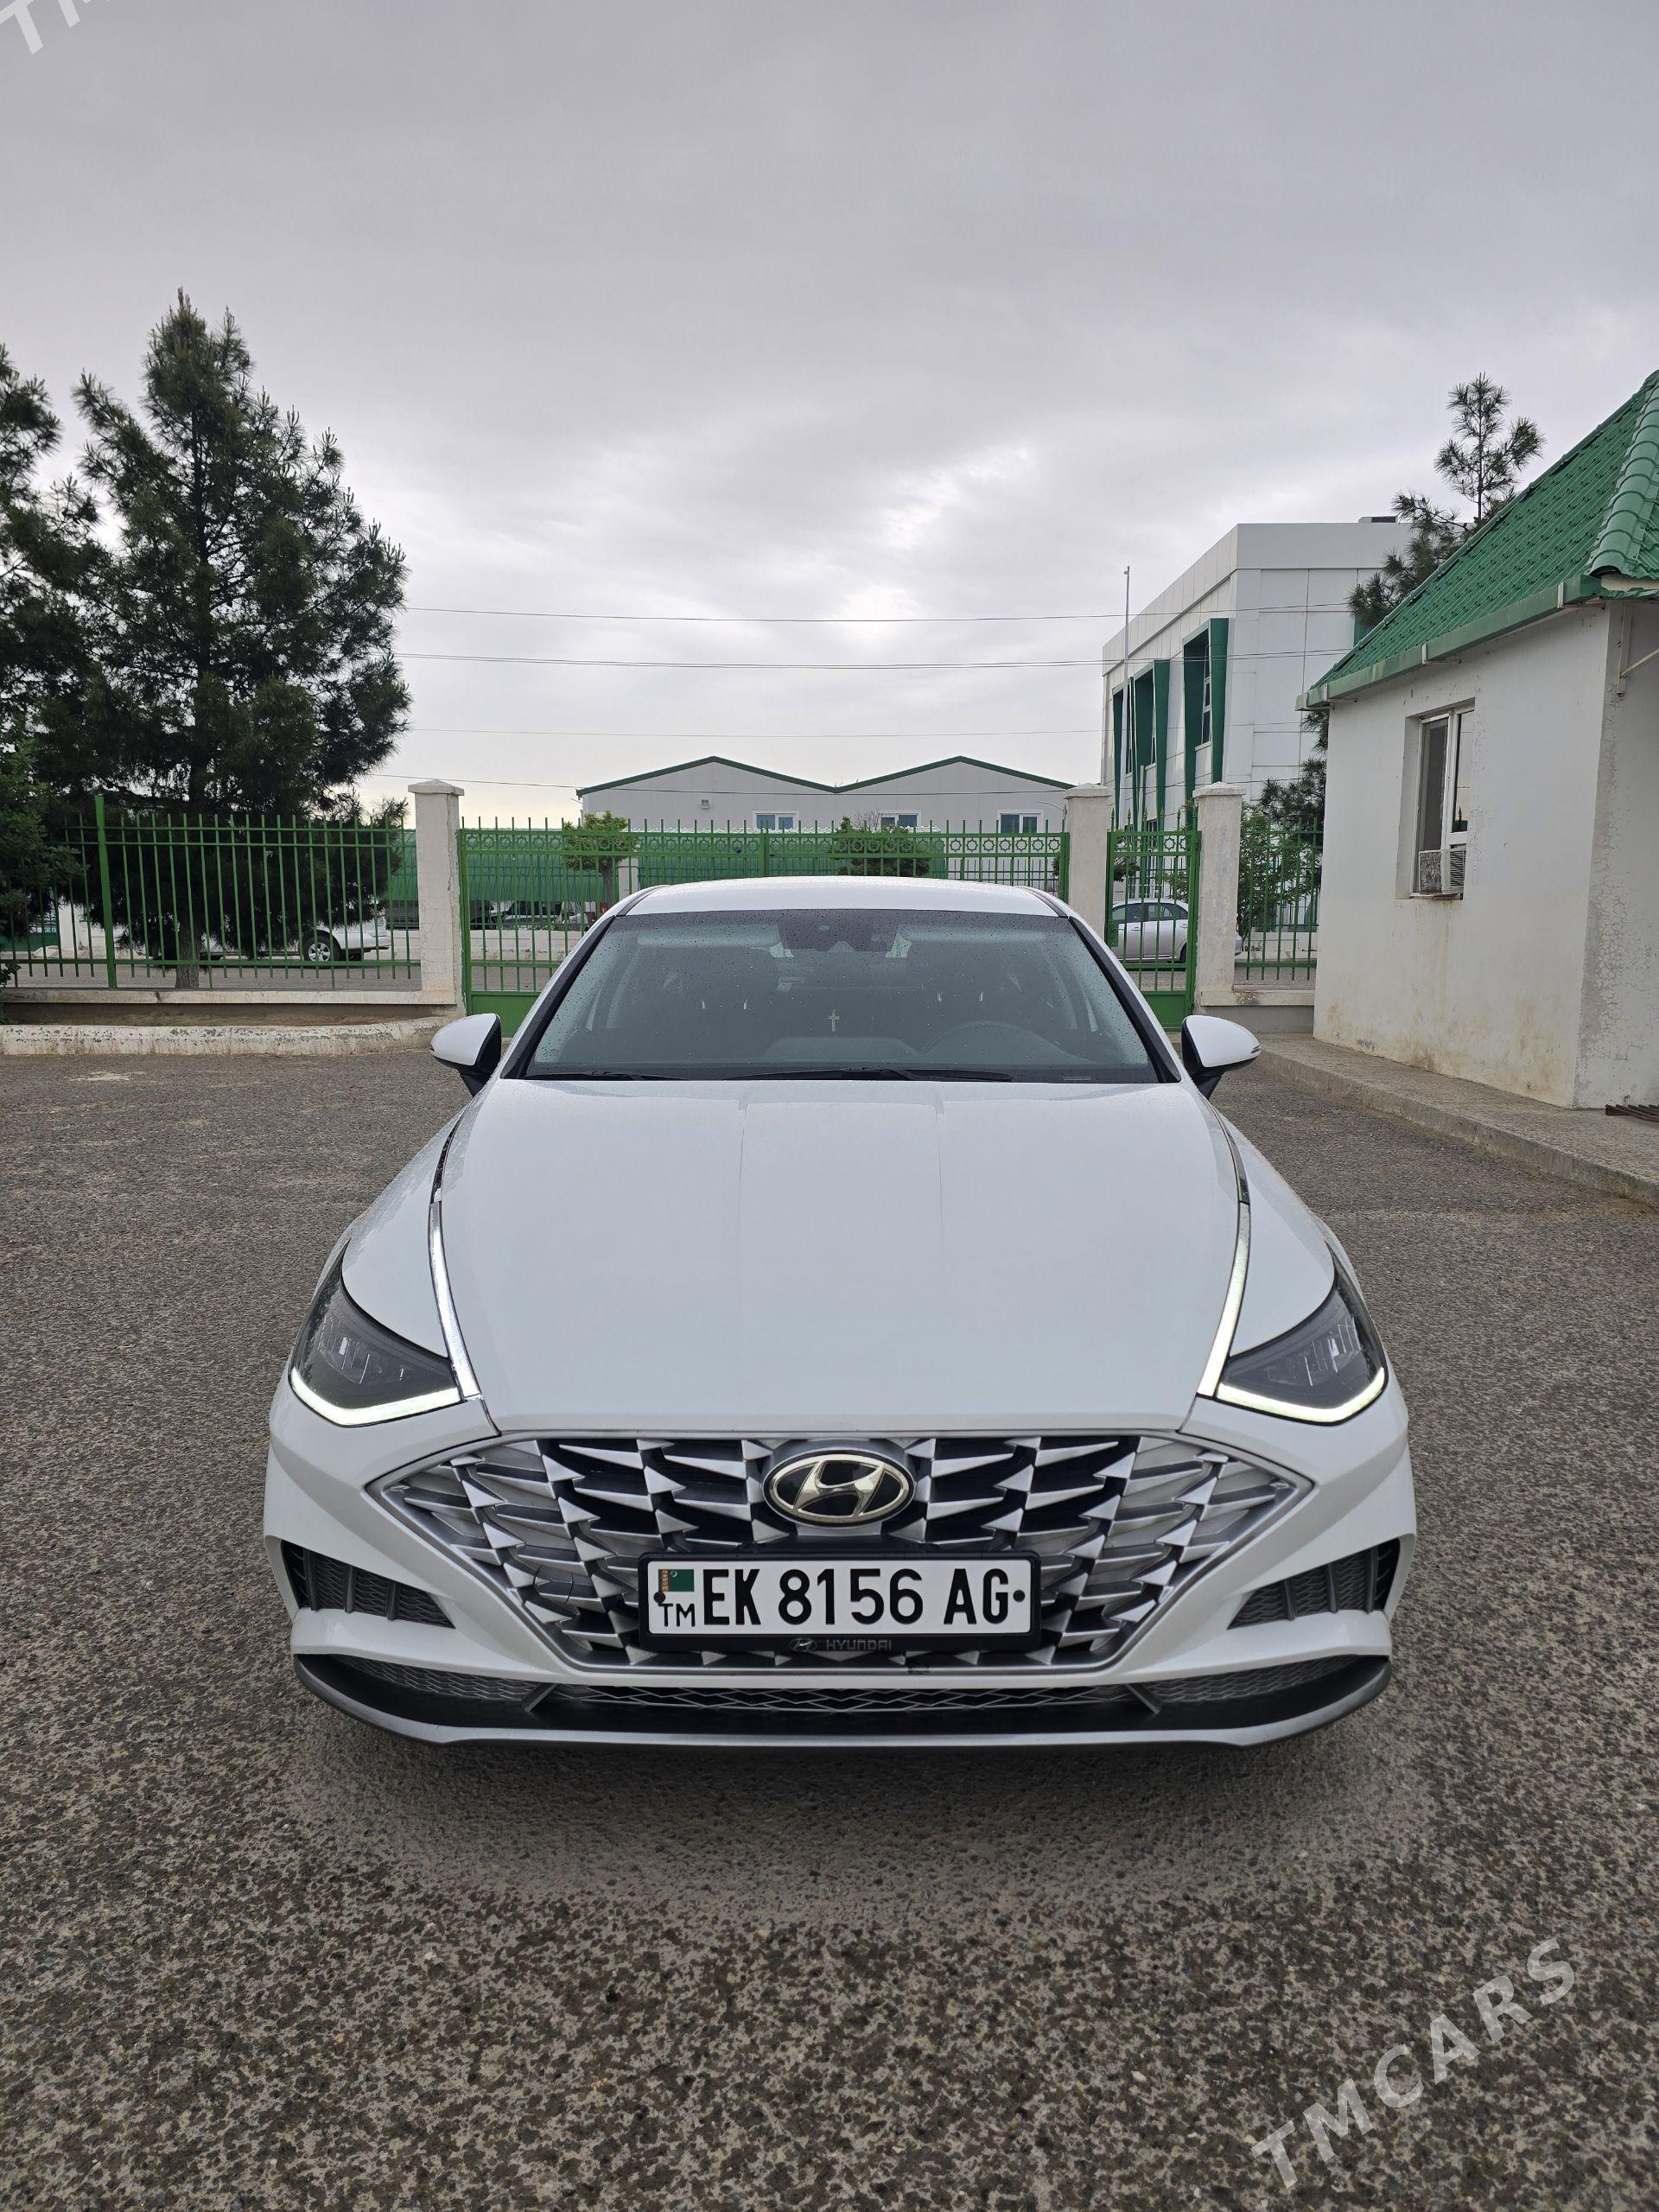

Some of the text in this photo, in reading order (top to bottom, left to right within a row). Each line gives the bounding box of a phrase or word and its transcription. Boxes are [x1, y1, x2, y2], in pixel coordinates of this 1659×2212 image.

[703, 1568, 1009, 1625] EK 8156 AG
[658, 1603, 696, 1627] TM
[826, 1639, 892, 1650] HYUNDAI
